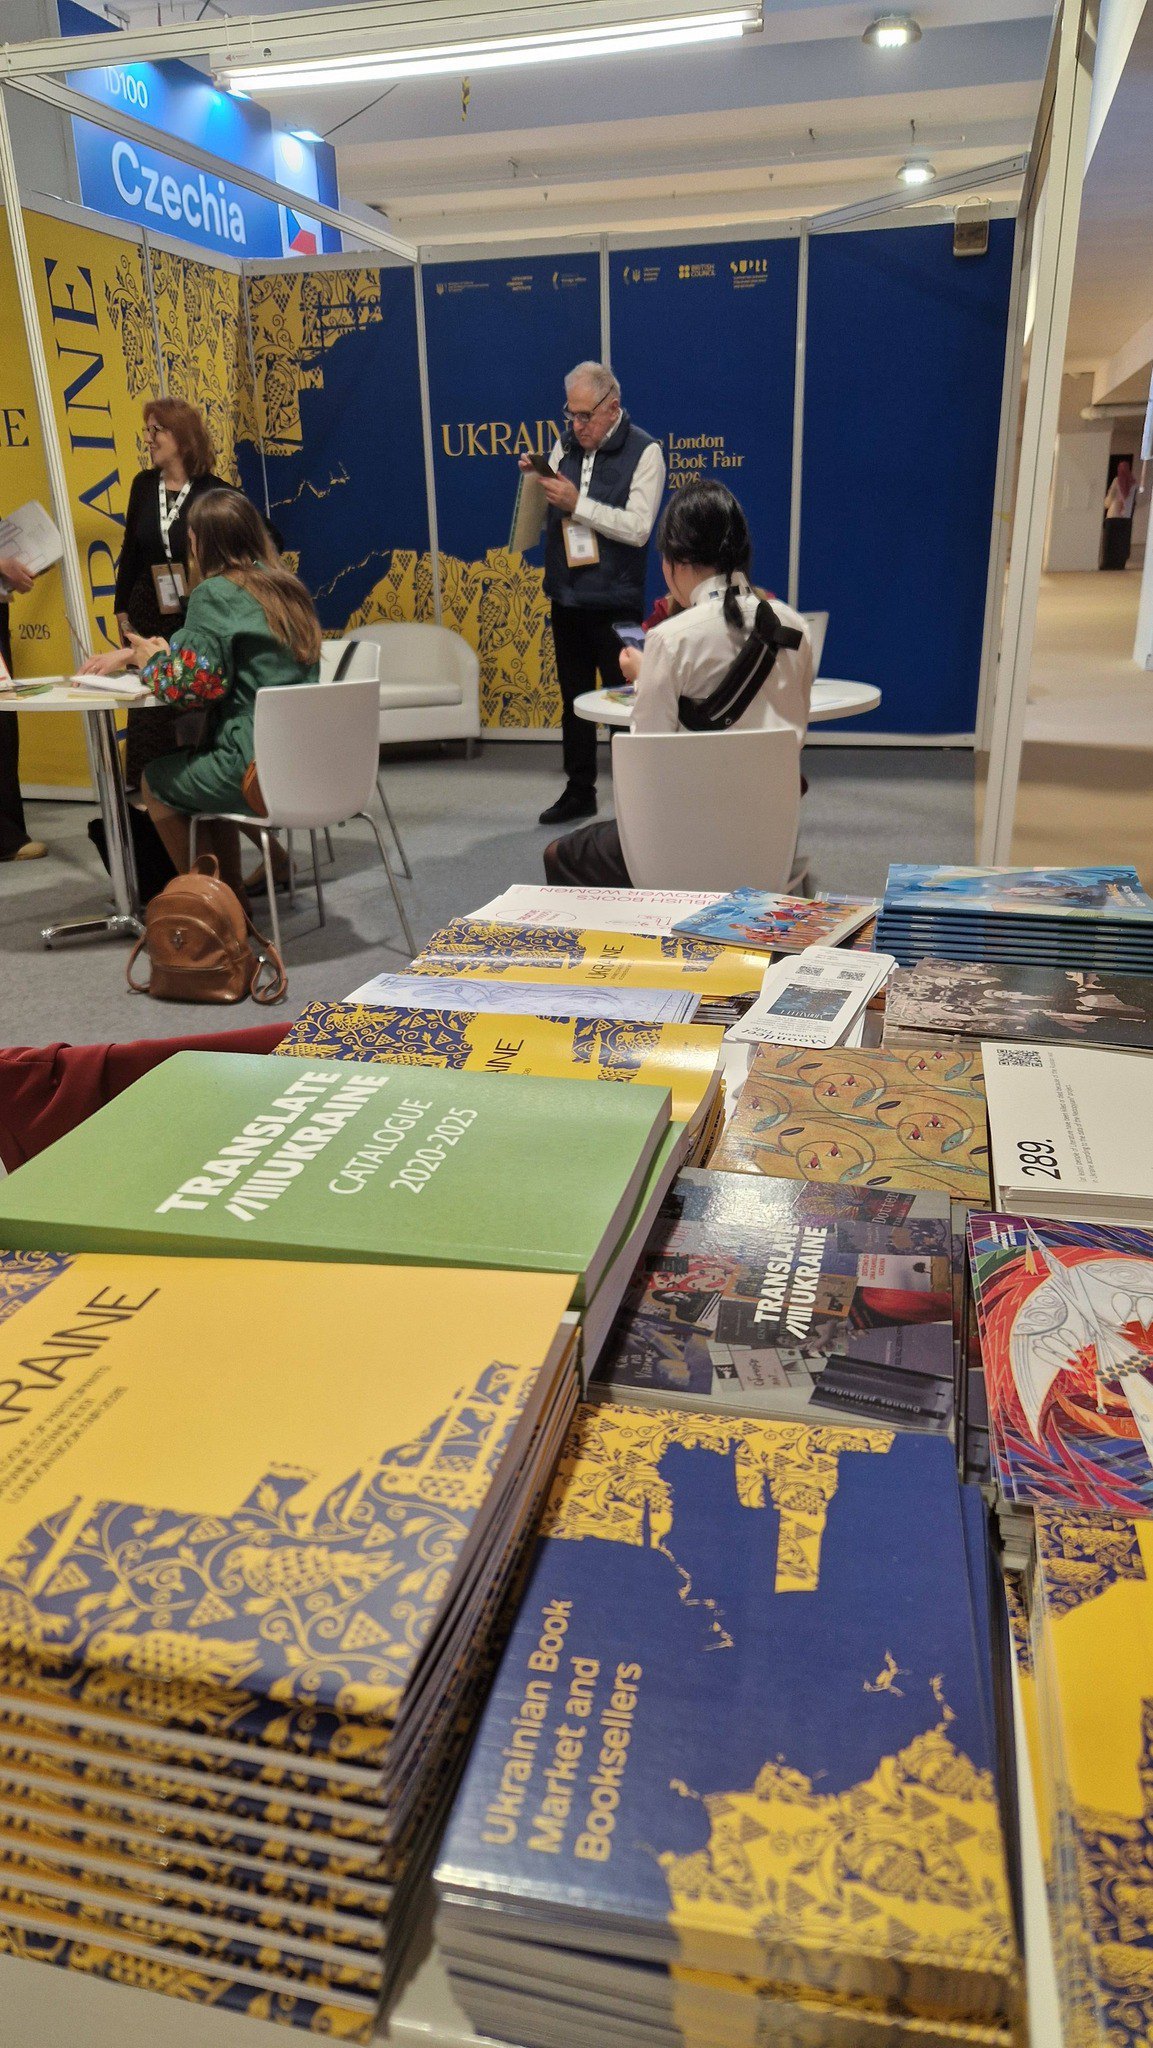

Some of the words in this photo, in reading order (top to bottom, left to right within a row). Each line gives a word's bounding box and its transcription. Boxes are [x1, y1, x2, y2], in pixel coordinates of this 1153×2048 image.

[112, 141, 247, 245] Czechia
[441, 419, 571, 456] UKRAIN
[669, 432, 724, 450] London
[669, 452, 707, 469] Book
[713, 450, 745, 468] Fair
[18, 623, 51, 640] 2026
[577, 894, 643, 903] BOOKS
[742, 1029, 826, 1045] Moonfleet
[154, 1072, 342, 1214] TRANSLATE
[328, 1098, 433, 1195] CATALOGUE
[389, 1107, 478, 1194] 2020-2025
[1017, 1139, 1061, 1180] 289.
[754, 1225, 799, 1323] TRANSLATE
[480, 1680, 553, 1845] Ukrainian
[527, 1599, 574, 1674] Book
[526, 1722, 588, 1854] Market
[565, 1656, 601, 1718] and
[573, 1661, 643, 1863] Booksellers
